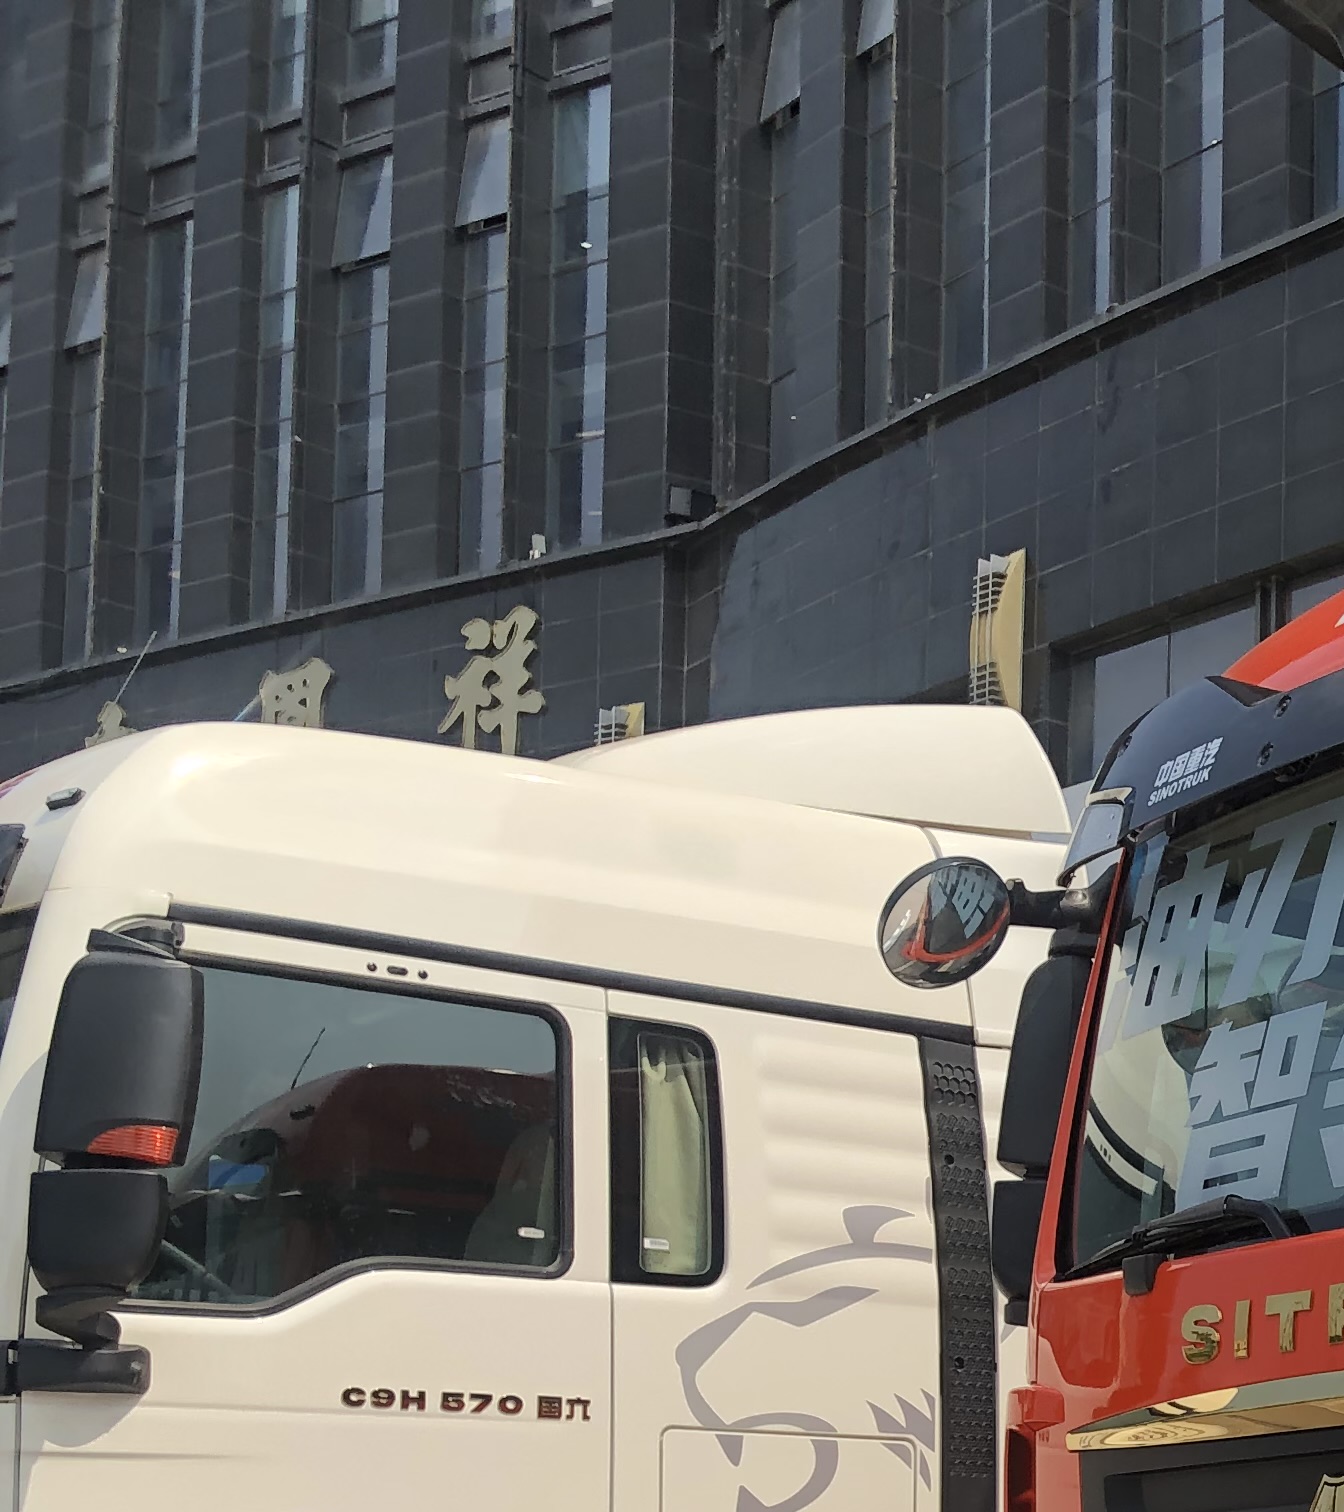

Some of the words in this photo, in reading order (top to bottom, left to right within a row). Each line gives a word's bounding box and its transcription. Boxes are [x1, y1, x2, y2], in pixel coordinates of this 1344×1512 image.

[1153, 737, 1224, 788] 中国重汽
[1147, 766, 1213, 807] SINOTRUK
[341, 1387, 427, 1411] C9H
[440, 1391, 524, 1416] 570
[537, 1395, 592, 1421] 国六
